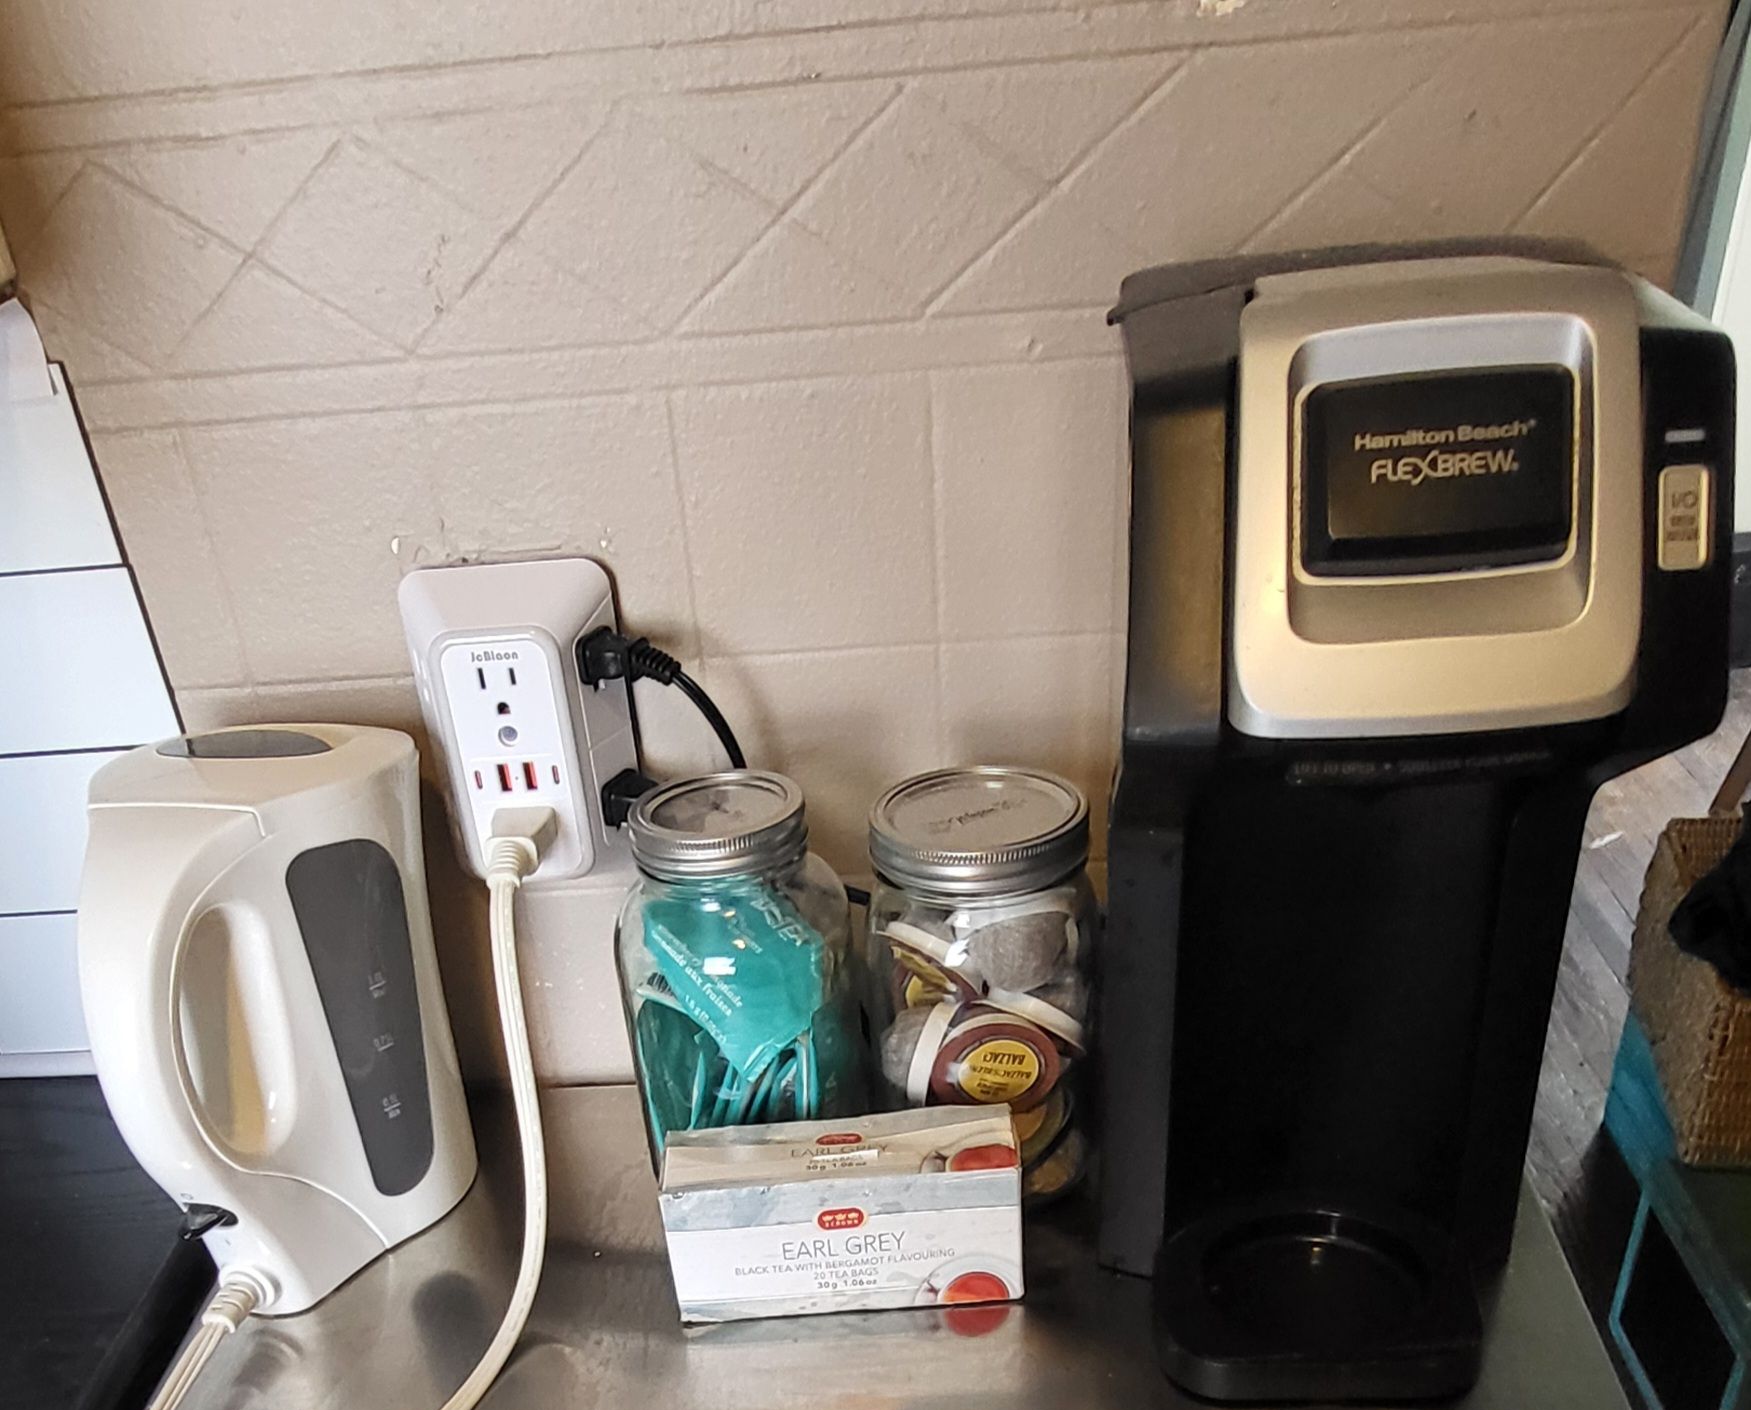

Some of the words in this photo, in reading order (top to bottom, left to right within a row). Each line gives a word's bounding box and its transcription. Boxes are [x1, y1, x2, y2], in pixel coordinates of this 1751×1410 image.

[1354, 428, 1454, 452] Hamilton
[1457, 420, 1529, 441] Beach
[782, 1239, 839, 1260] EARL
[845, 1231, 905, 1255] GREY
[735, 1266, 769, 1276] BLACK
[772, 1264, 793, 1273] TEA
[795, 1261, 822, 1272] WITH
[825, 1256, 884, 1269] BERGAMOT
[887, 1248, 955, 1263] FLAVOURING
[814, 1271, 826, 1280] 20
[829, 1269, 848, 1279] TEA
[851, 1267, 879, 1277] BAGS
